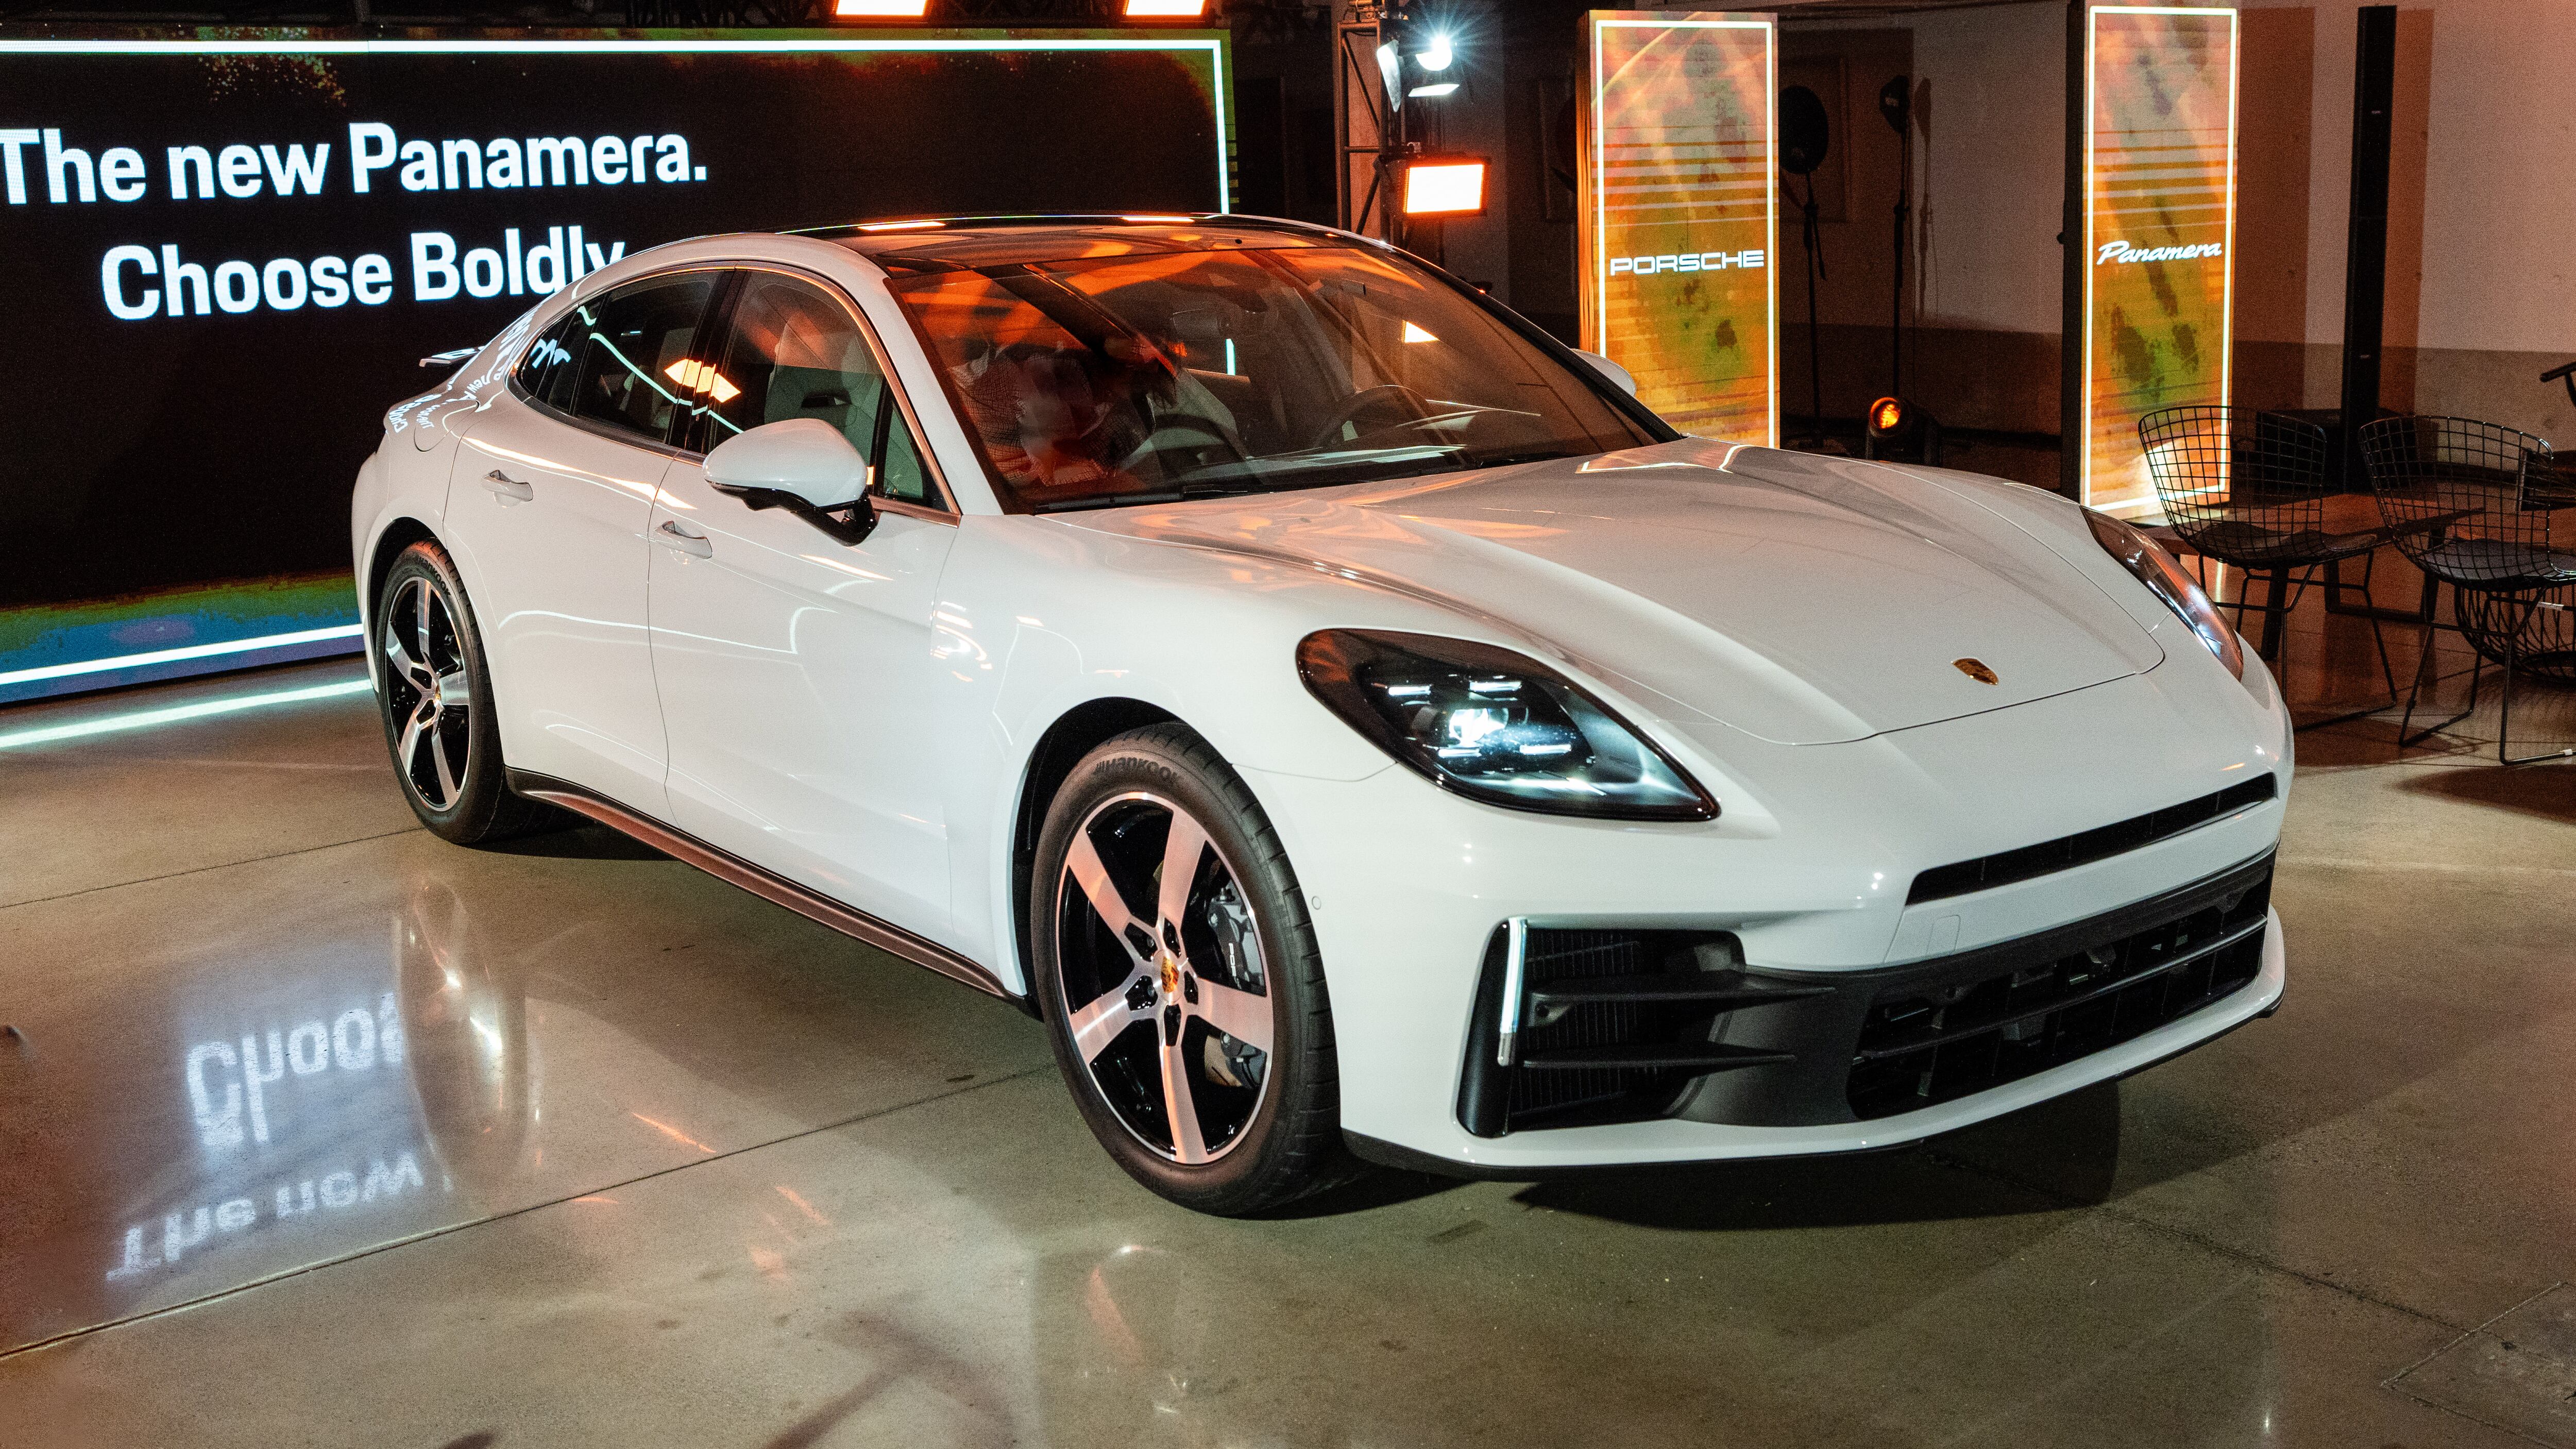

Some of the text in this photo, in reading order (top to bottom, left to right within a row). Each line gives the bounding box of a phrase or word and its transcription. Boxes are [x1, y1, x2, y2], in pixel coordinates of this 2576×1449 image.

[0, 123, 707, 205] The new Panamera.
[1609, 250, 1765, 276] PORSCHE
[2096, 240, 2223, 265] Panamera
[101, 244, 392, 320] Choose
